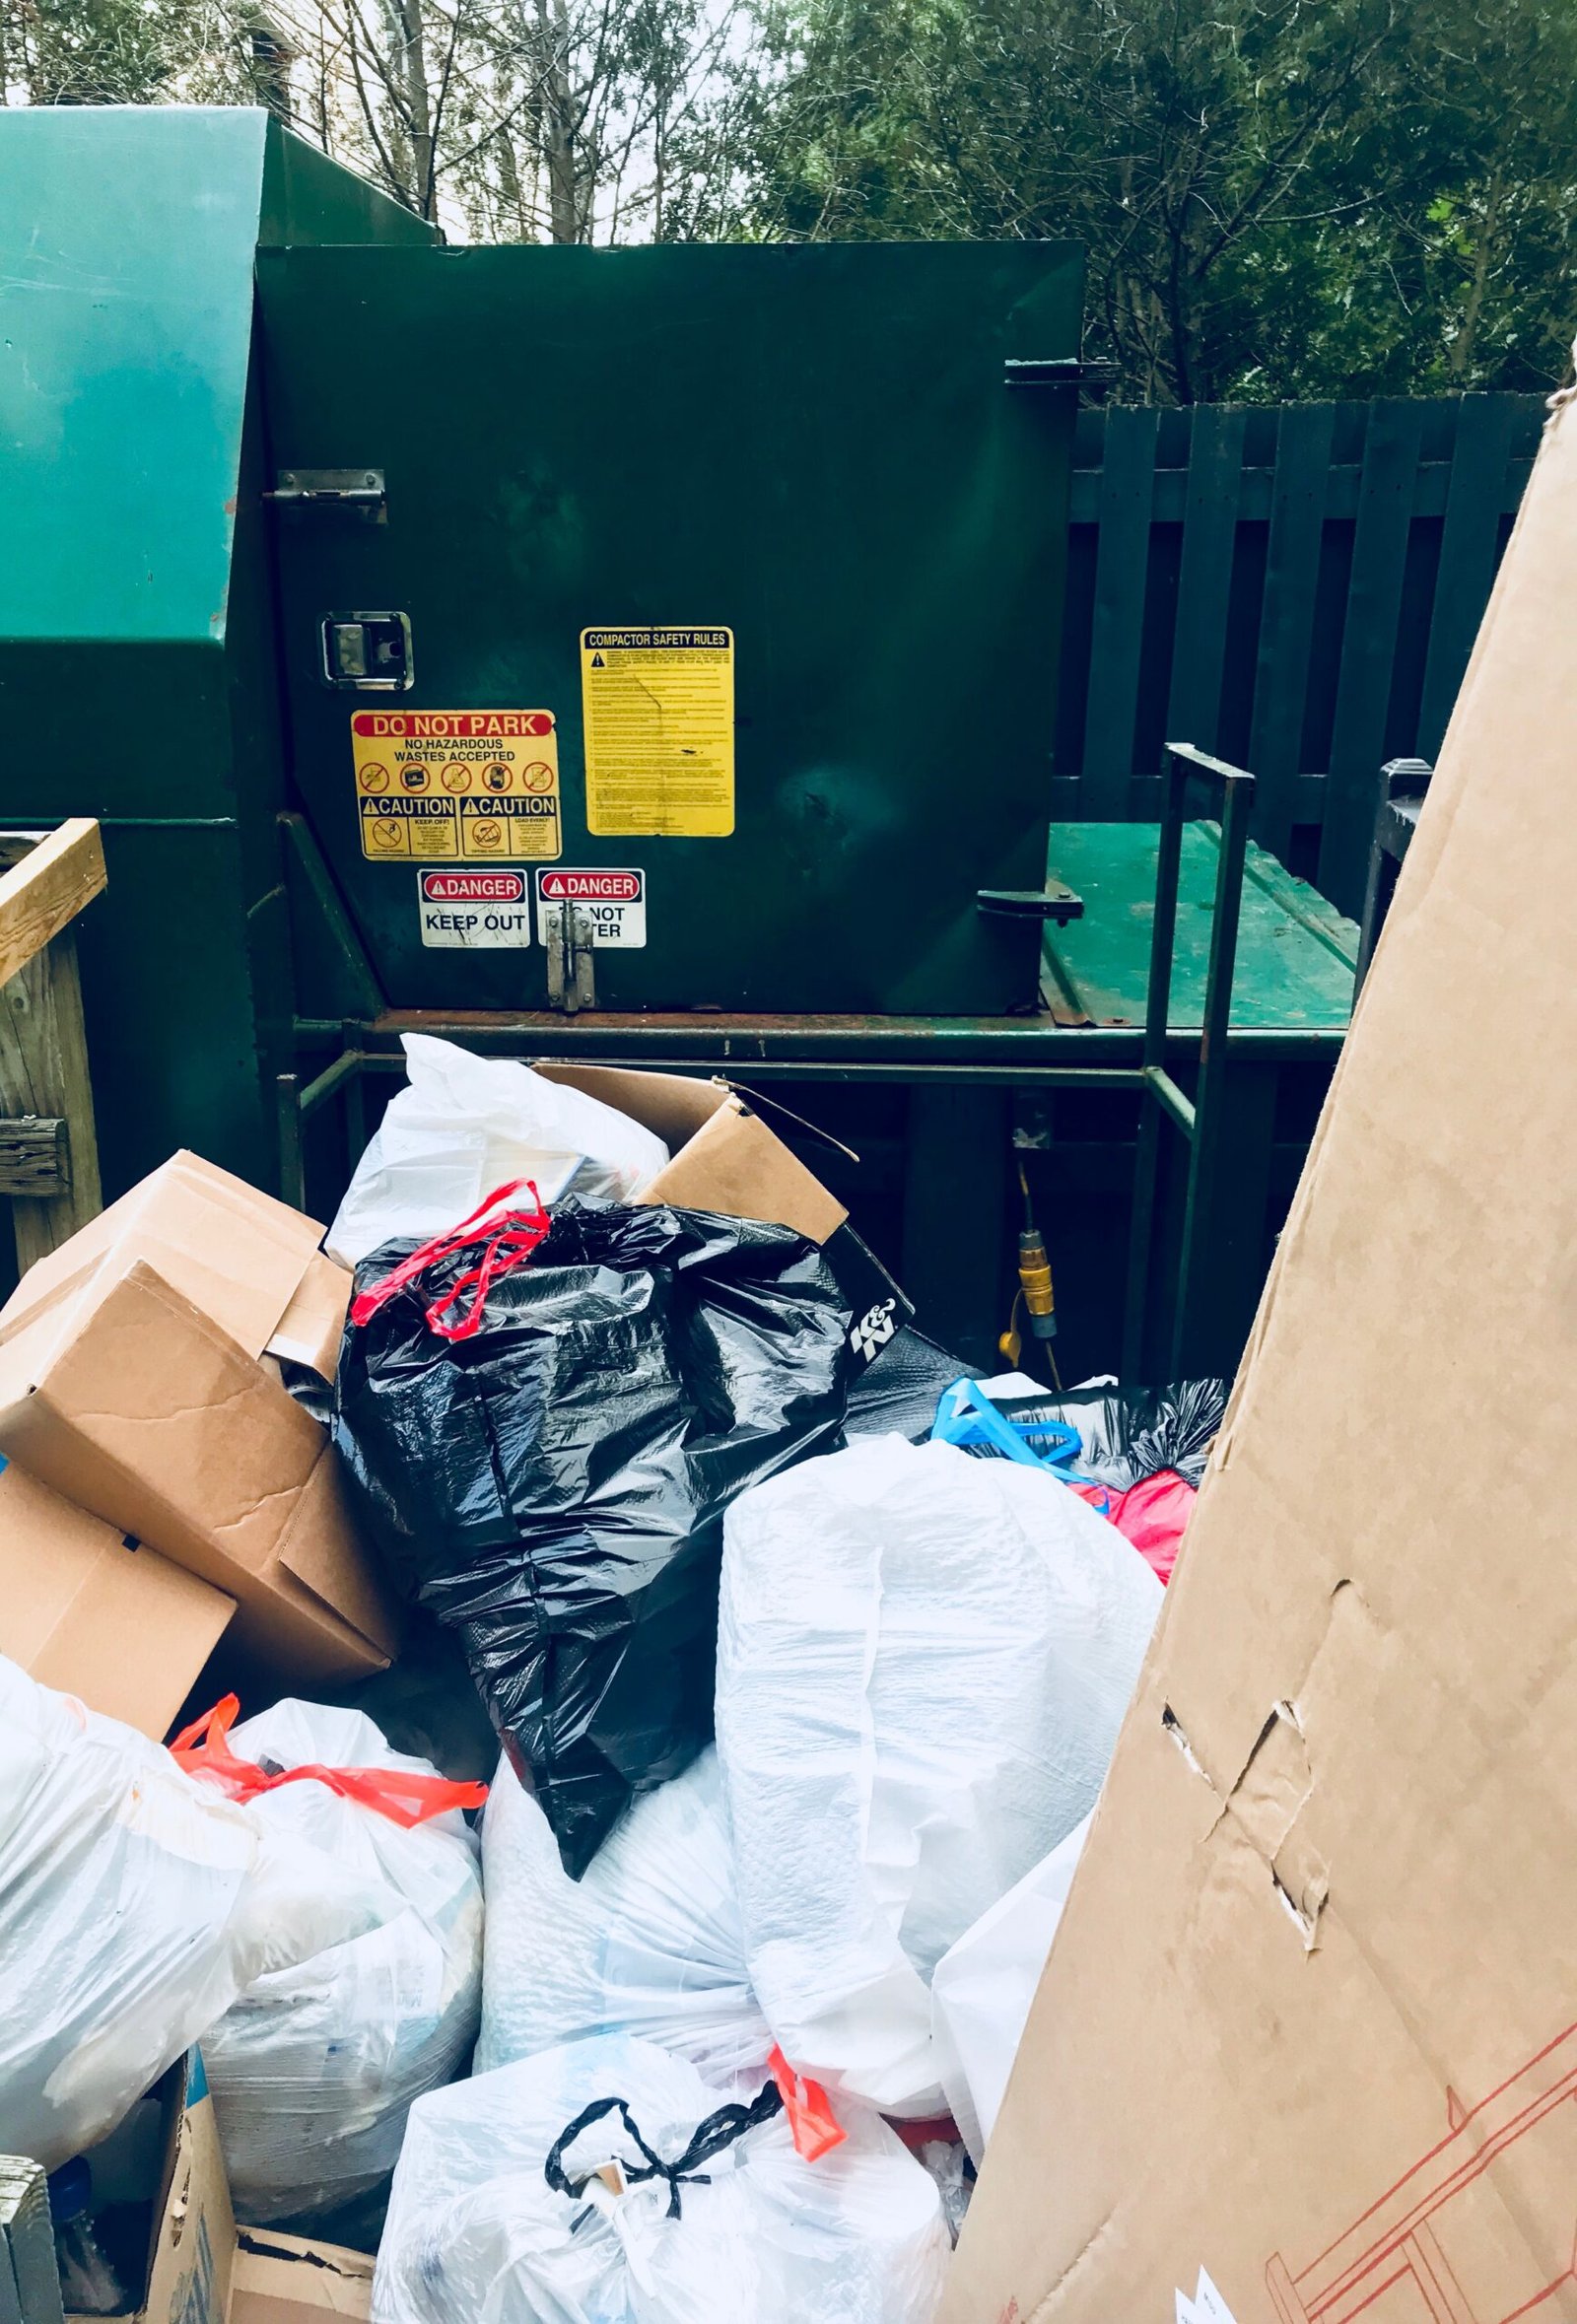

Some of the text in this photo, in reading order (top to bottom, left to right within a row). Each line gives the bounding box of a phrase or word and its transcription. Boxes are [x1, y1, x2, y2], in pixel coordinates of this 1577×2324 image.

[588, 633, 725, 647] COMPACTOR SAFETY RULES
[373, 716, 538, 735] DO NOT PARK
[405, 738, 503, 749] NO HAZARDOUS
[394, 751, 515, 762] WASTES ACCEPTED
[379, 798, 454, 814] CAUTION
[479, 797, 555, 814] CAUTION
[447, 879, 517, 896] DANGER
[568, 878, 634, 895] DANGER
[589, 907, 625, 921] NOT
[426, 915, 525, 930] KEEP OUT
[850, 1297, 896, 1363] K&N
